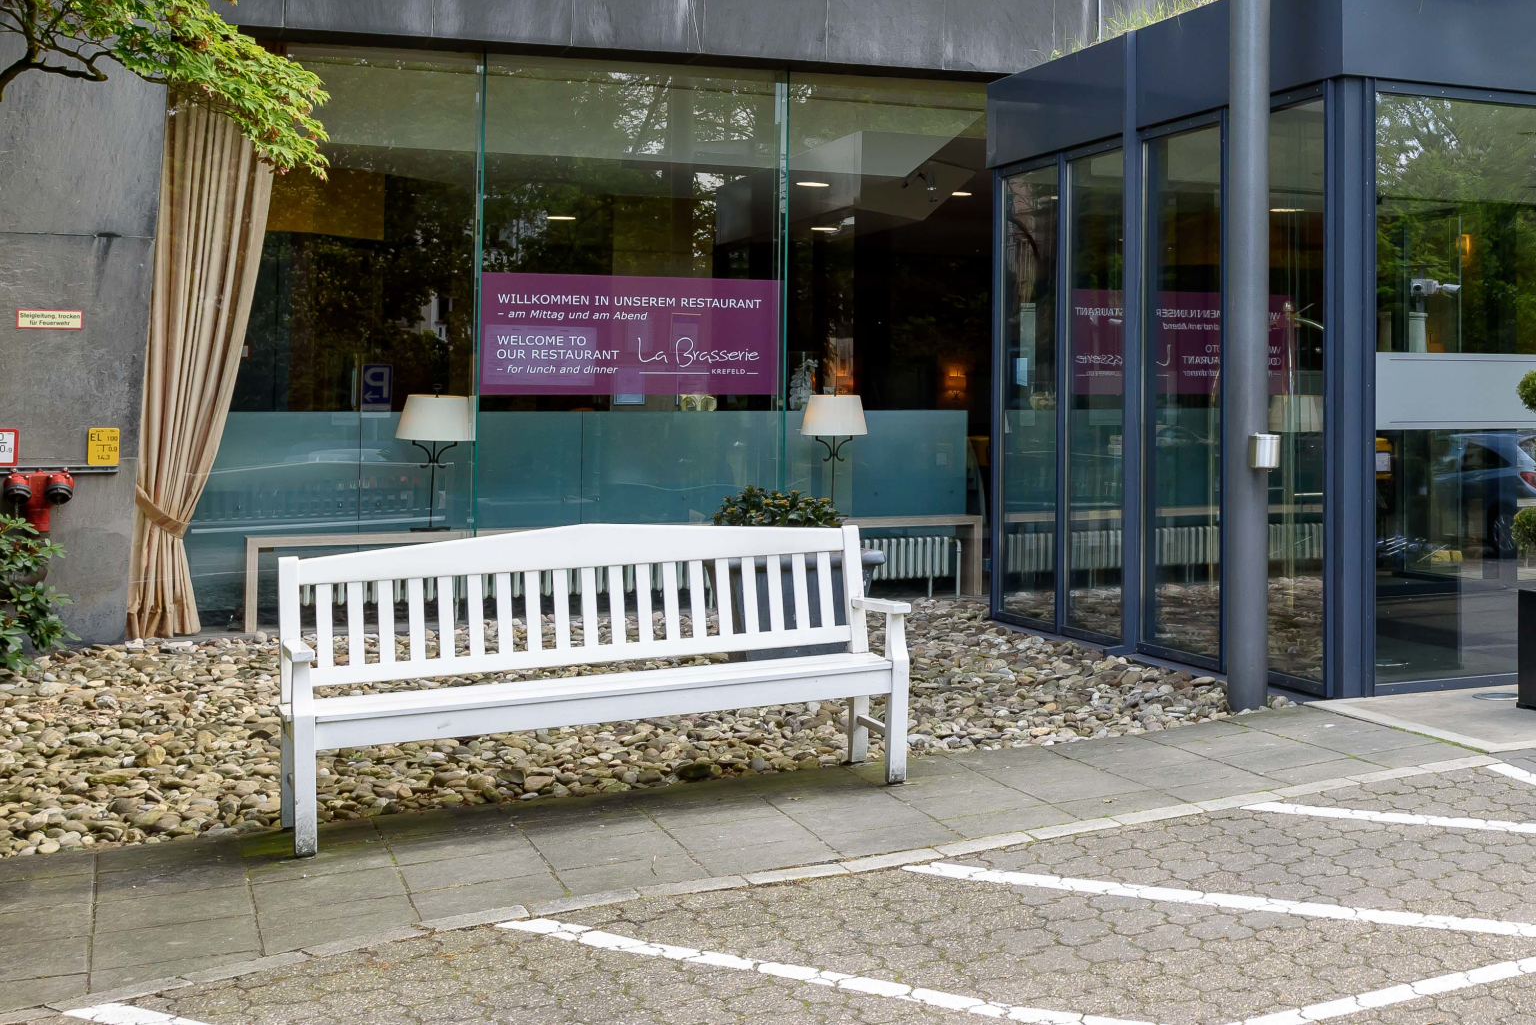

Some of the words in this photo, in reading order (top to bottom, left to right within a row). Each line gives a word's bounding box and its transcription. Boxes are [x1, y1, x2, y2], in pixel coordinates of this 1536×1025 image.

[498, 294, 590, 306] WILLKOMMEN
[594, 296, 609, 306] IN
[614, 296, 676, 307] UNSEREM
[680, 298, 762, 309] RESTAURANT
[530, 310, 564, 320] Mittag
[568, 310, 590, 320] und
[613, 312, 648, 320] Abend
[497, 335, 564, 346] WELCOME
[569, 336, 587, 346] TO
[496, 349, 526, 359] OUR
[531, 350, 620, 360] RESTAURANT
[637, 337, 668, 364] La
[675, 336, 760, 368] Brasserie
[506, 364, 523, 374] for
[526, 365, 556, 374] lunch
[559, 365, 584, 374] and
[587, 365, 618, 374] dinner
